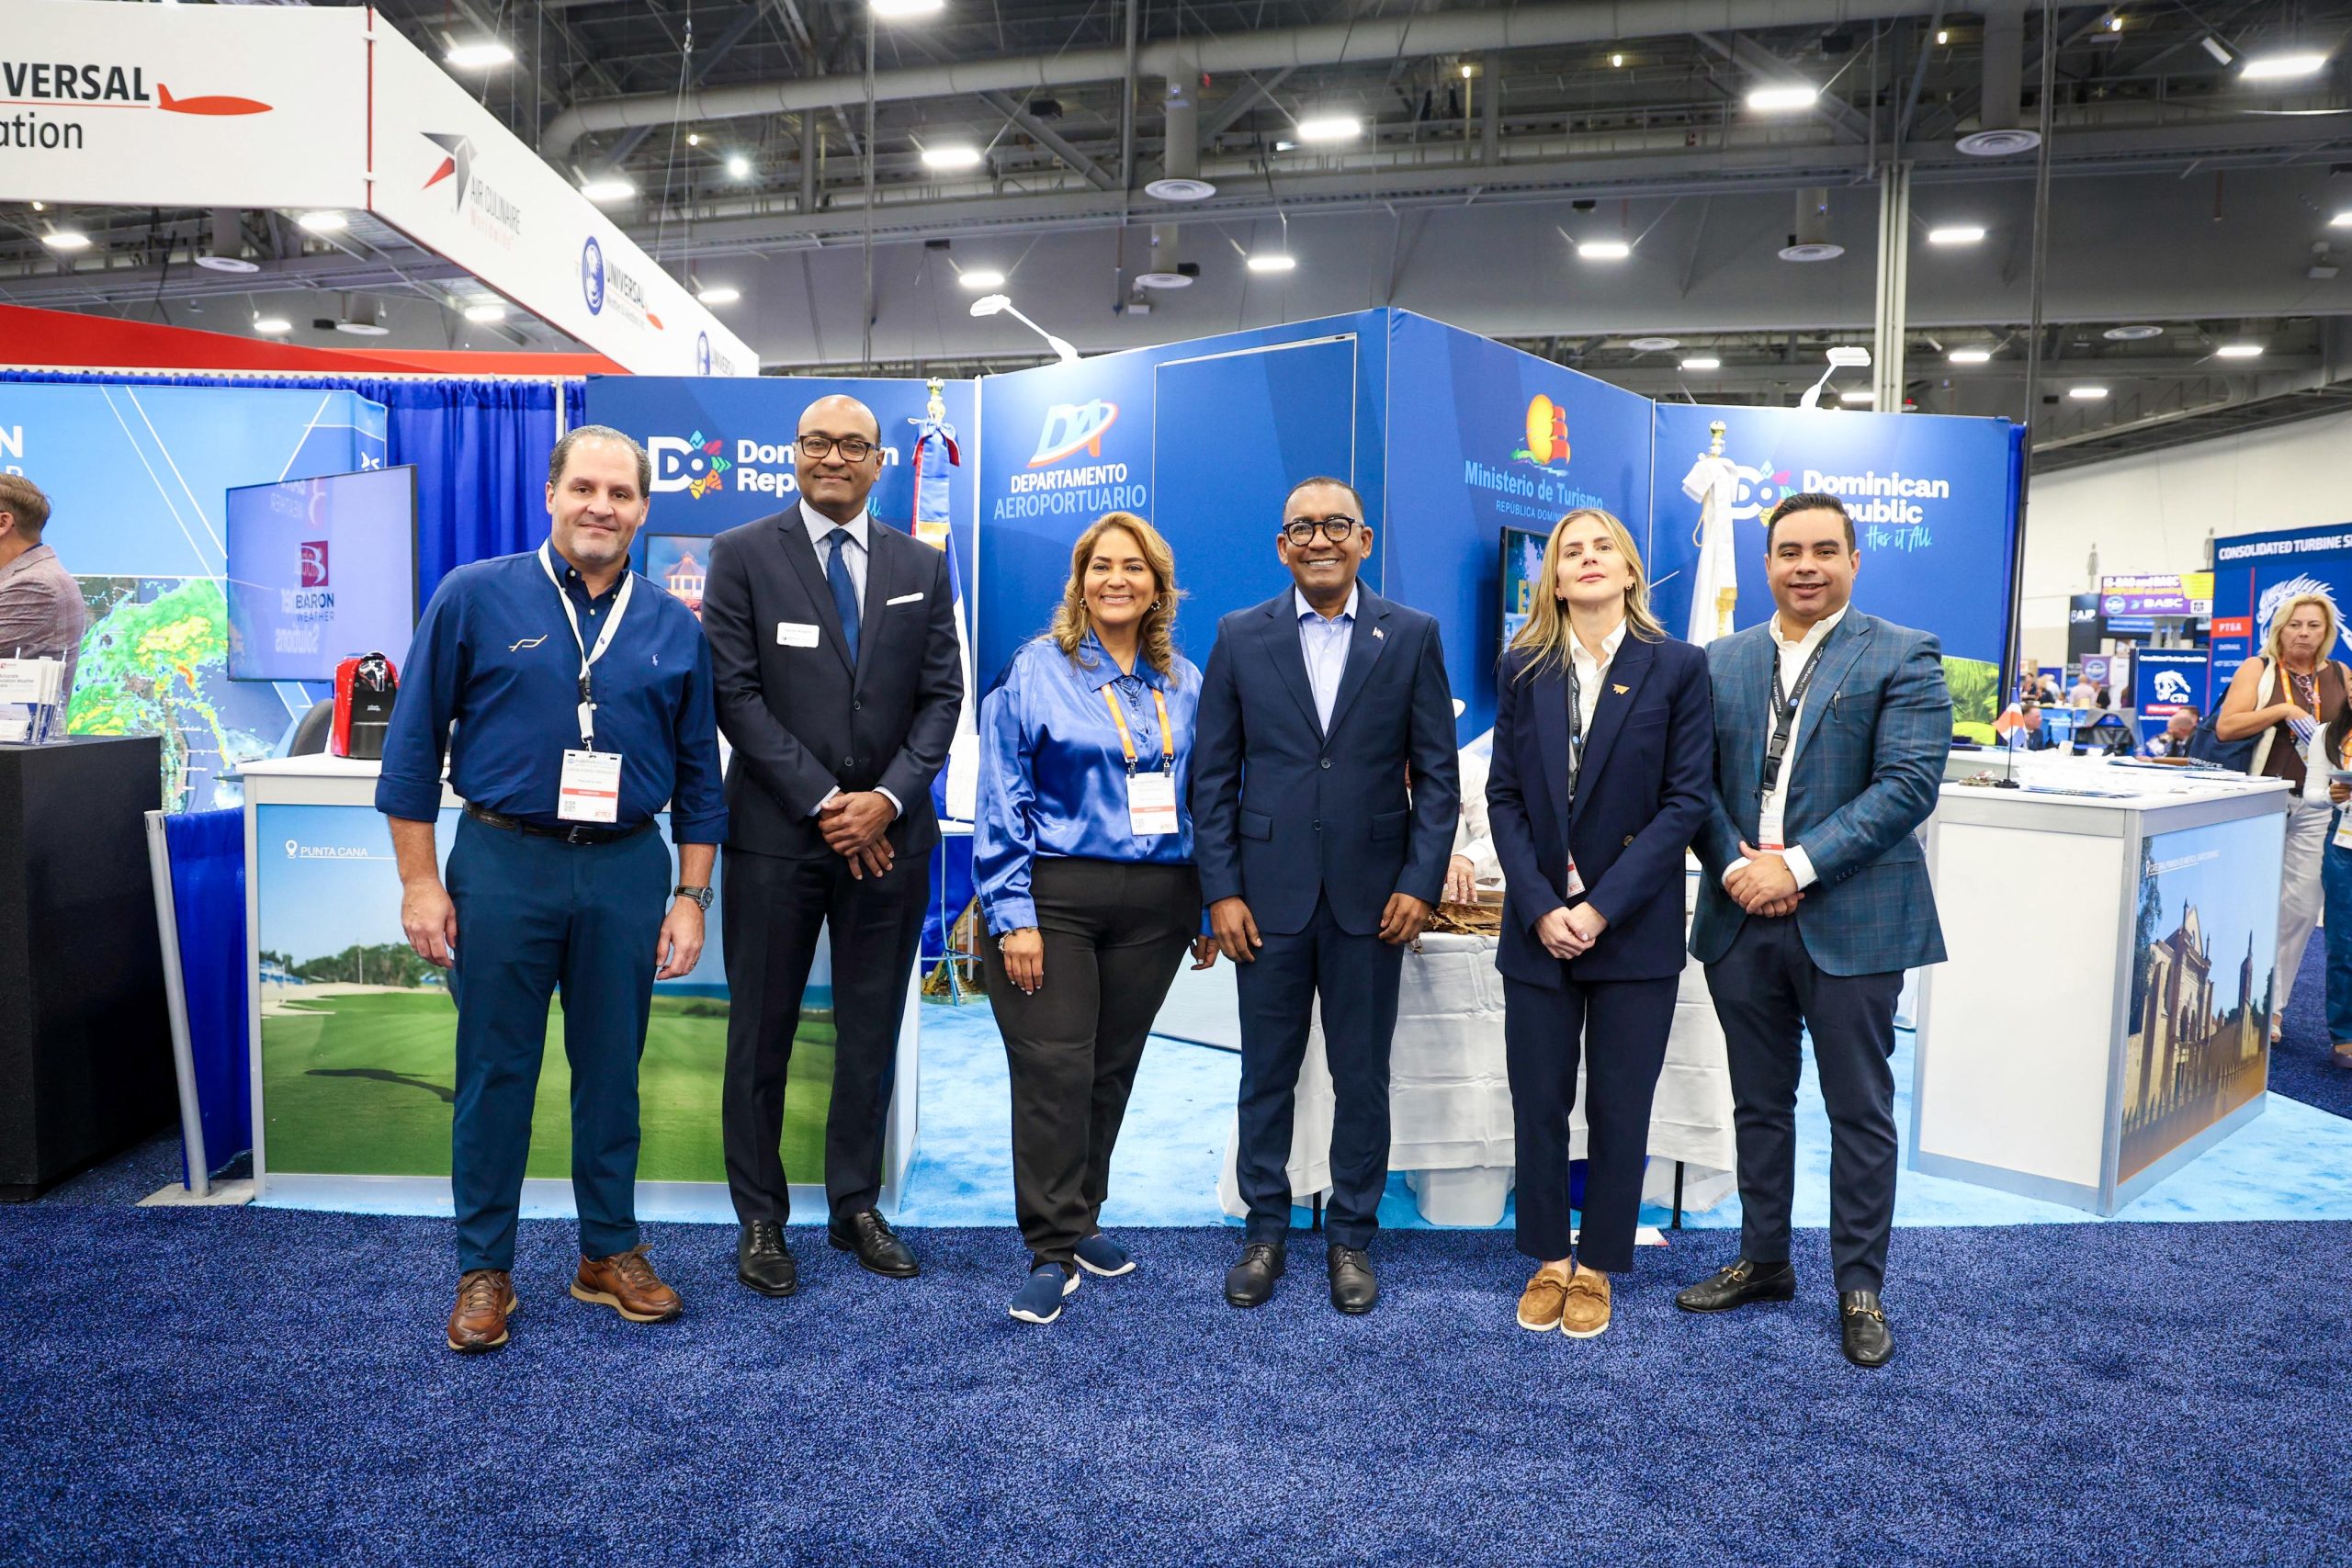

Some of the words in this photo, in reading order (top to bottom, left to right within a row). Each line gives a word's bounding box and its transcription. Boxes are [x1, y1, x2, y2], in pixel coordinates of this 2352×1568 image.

[470, 175, 483, 208] AIR
[485, 186, 521, 236] CULINAIRE
[606, 260, 645, 309] UNIVERSAL
[1011, 463, 1128, 493] DEPARTAMENTO
[1464, 460, 1534, 498] Ministerio
[1537, 479, 1554, 502] de
[1556, 482, 1603, 512] Turismo
[1803, 469, 1950, 499] Dominican
[994, 484, 1148, 520] AEROPORTUARIO
[1496, 499, 1536, 519] REPÚBLICA
[1863, 526, 1892, 550] Has
[2219, 540, 2293, 561] CONSOLIDATED
[2293, 536, 2342, 553] TURBINE
[296, 593, 334, 609] BARON
[2143, 598, 2185, 608] BASC
[296, 611, 334, 622] WEATHER
[2219, 623, 2243, 633] PT6A
[300, 846, 336, 856] PUNTA
[337, 847, 368, 857] CANA
